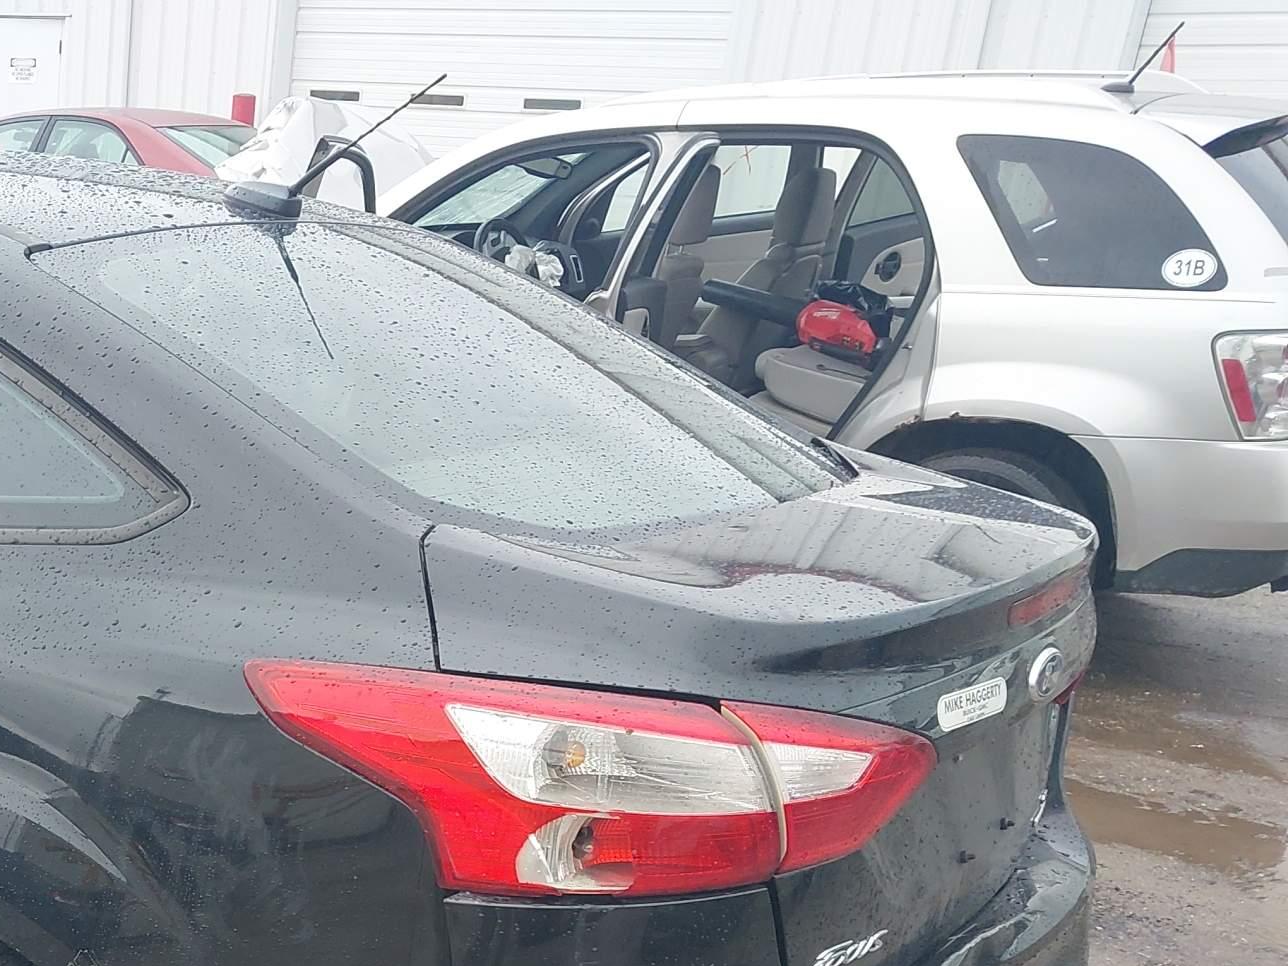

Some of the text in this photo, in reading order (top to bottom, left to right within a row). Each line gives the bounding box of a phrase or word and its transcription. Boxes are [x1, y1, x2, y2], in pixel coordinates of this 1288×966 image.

[1174, 259, 1205, 276] 31B
[944, 683, 1002, 714] MIKE HAGGERTY
